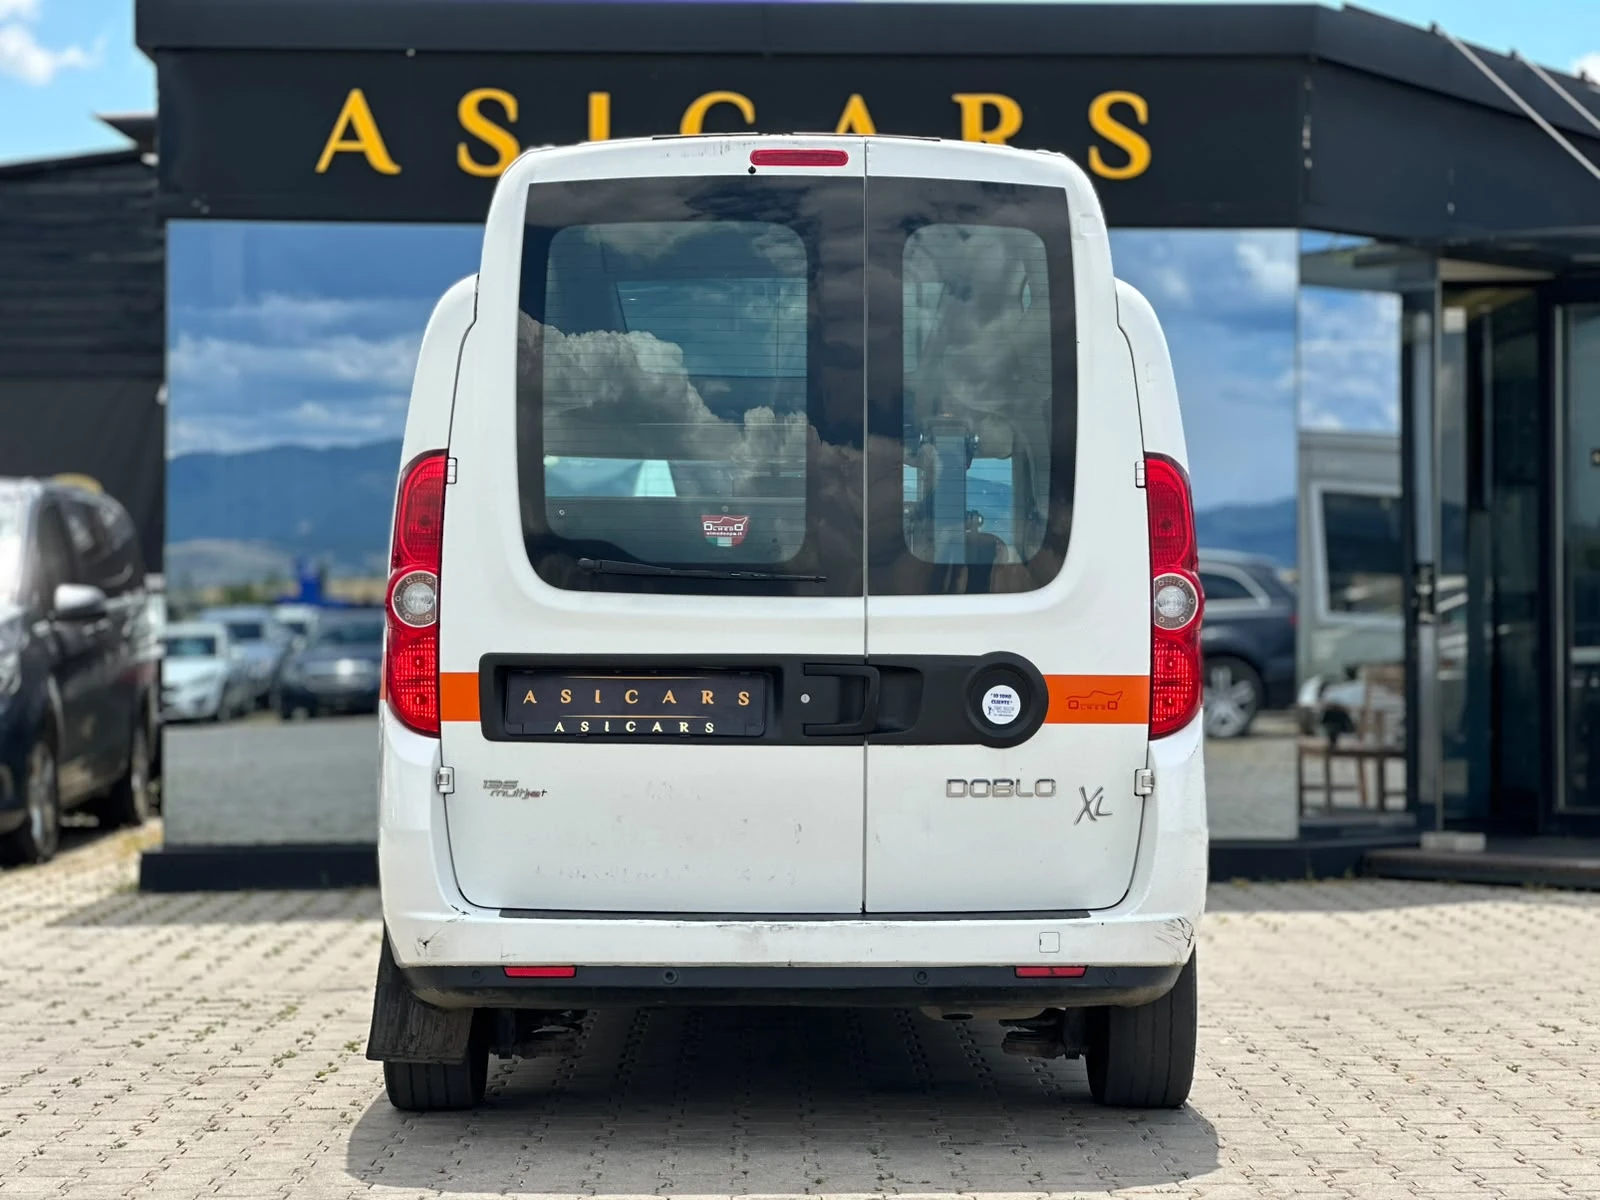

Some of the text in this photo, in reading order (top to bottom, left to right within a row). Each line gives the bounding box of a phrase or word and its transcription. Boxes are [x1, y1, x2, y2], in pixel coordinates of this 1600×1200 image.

[523, 689, 750, 706] ASICARS
[554, 721, 714, 733] ASICARS
[946, 778, 1056, 798] DOBLO
[1073, 786, 1113, 826] XL
